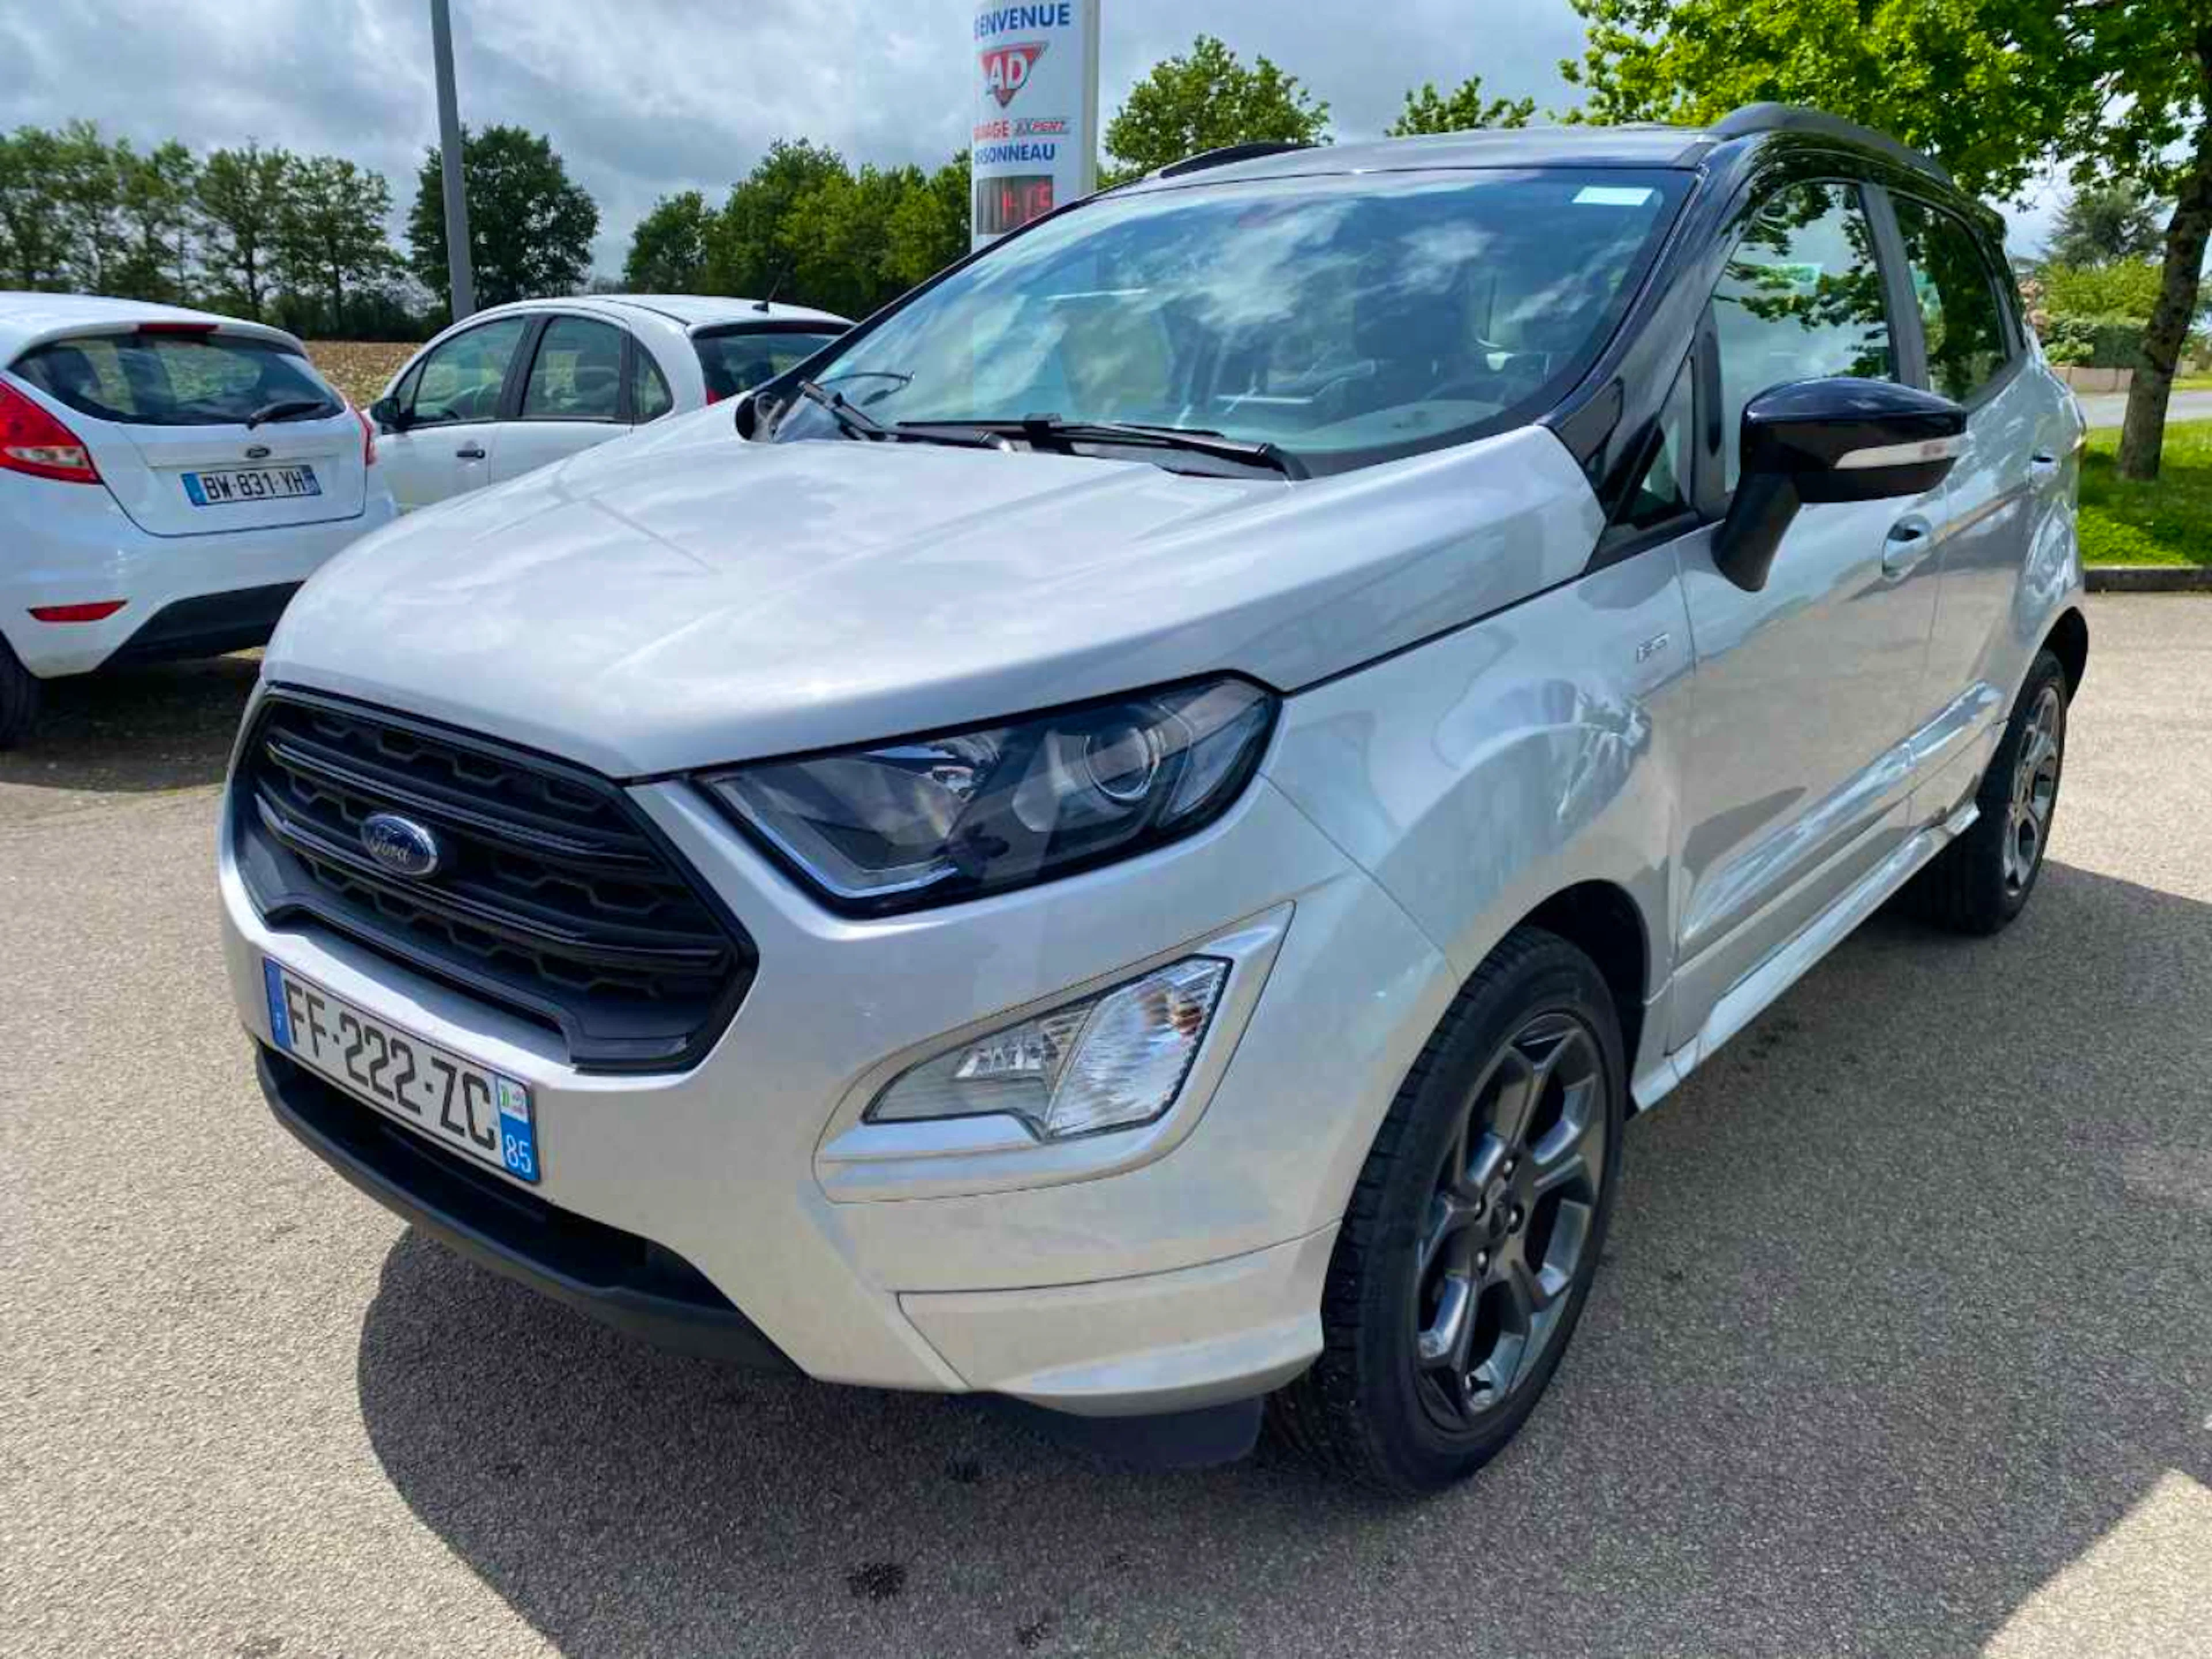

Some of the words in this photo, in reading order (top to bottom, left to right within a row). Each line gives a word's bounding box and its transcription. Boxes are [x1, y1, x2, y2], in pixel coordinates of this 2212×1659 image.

[974, 3, 1070, 40] ENVENUE
[988, 50, 1029, 90] AD
[285, 979, 495, 1150] FF-222-ZC
[505, 1134, 532, 1174] 85
